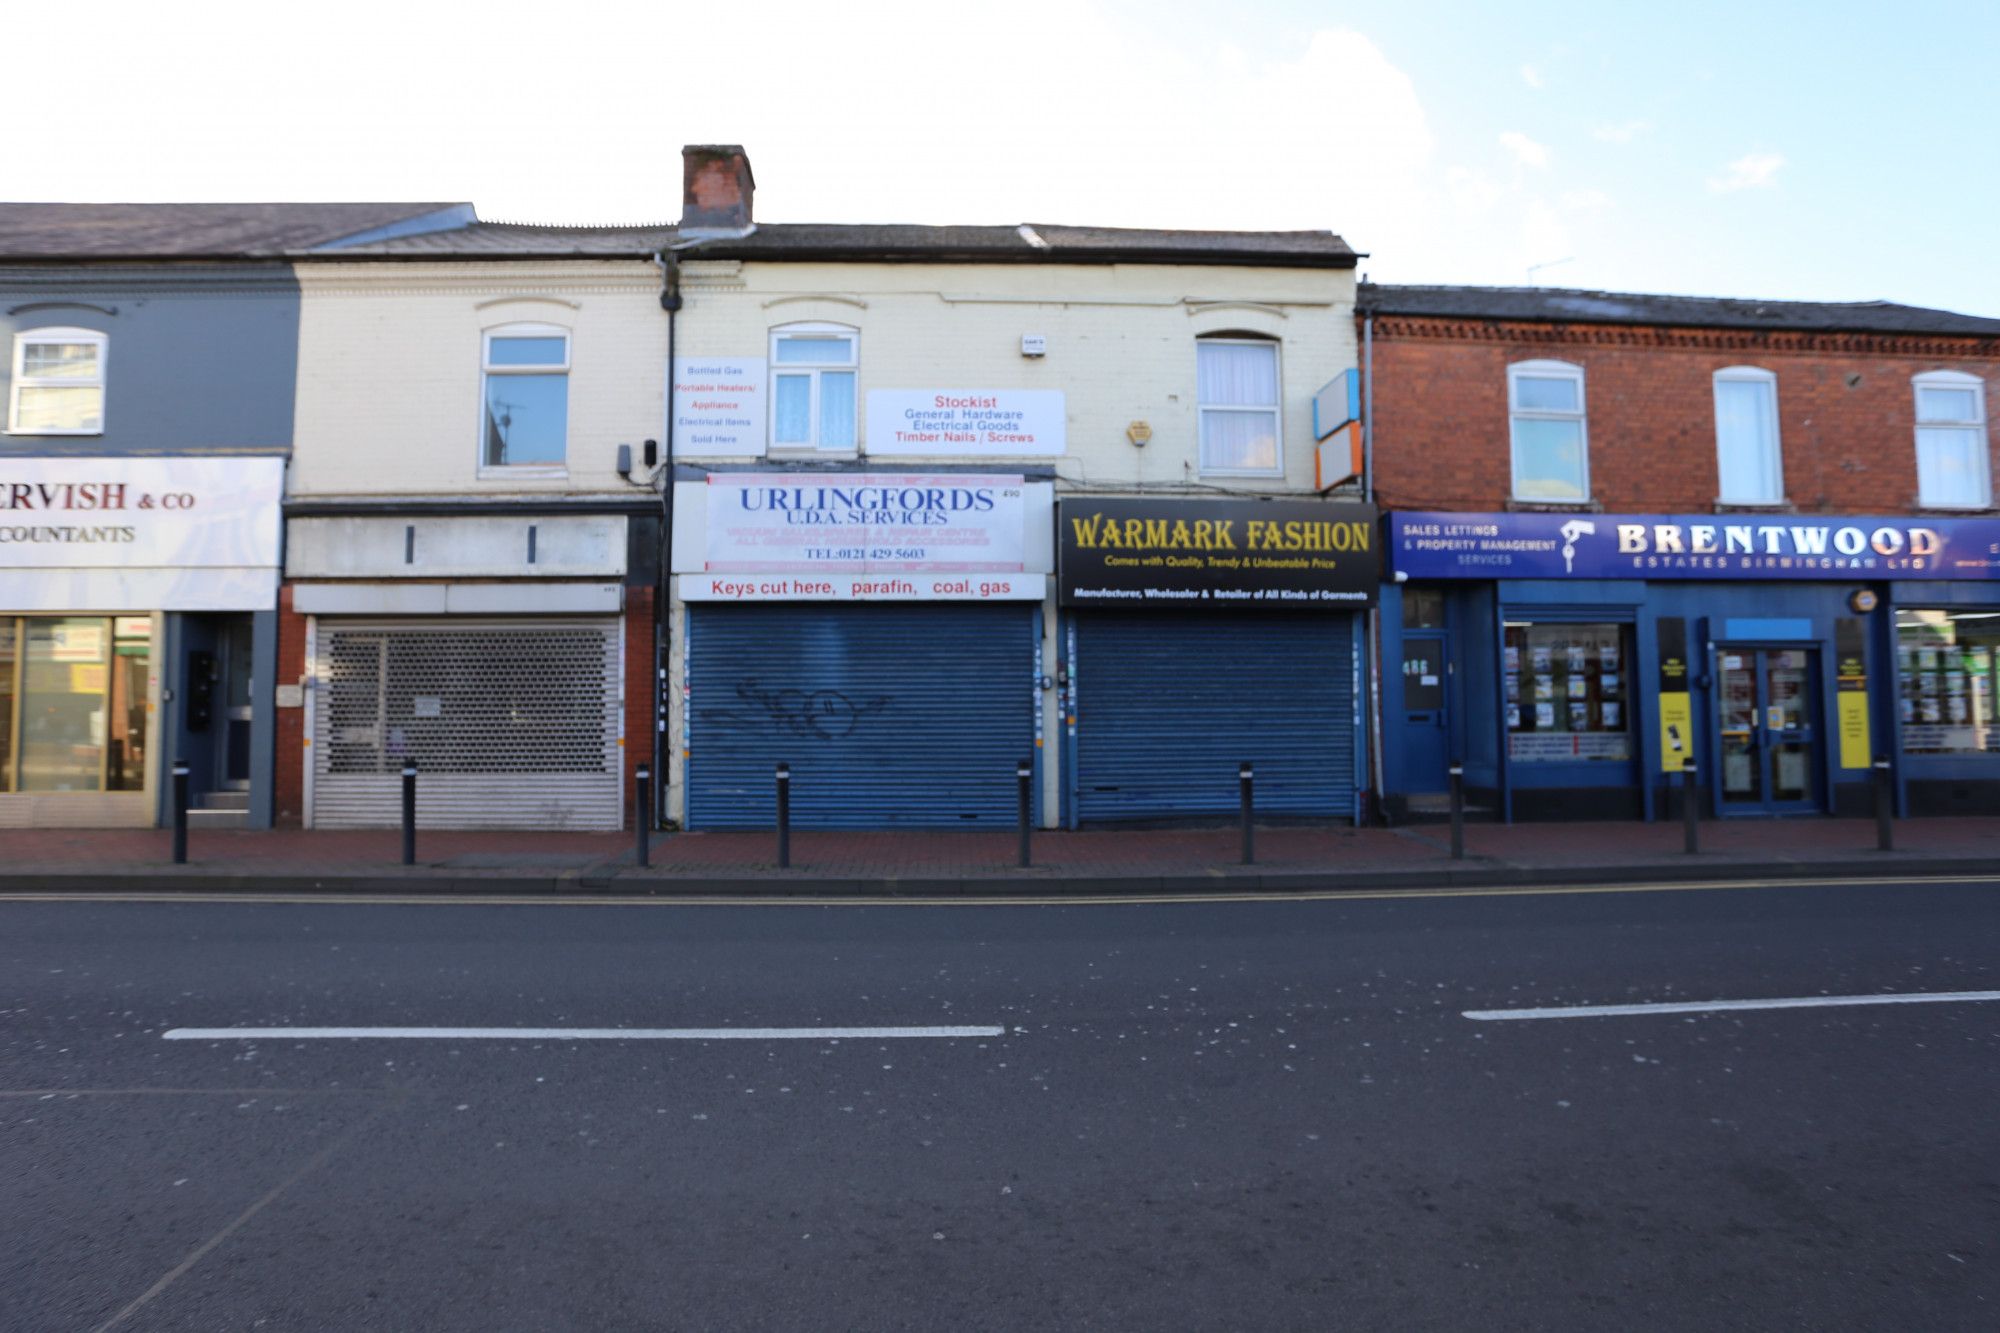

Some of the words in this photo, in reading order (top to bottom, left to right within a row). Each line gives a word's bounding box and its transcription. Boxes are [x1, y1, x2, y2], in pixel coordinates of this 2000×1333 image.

[935, 395, 997, 408] Stockist
[904, 408, 954, 420] General
[962, 409, 1023, 420] Hardware
[913, 420, 973, 431] Electrical
[977, 420, 1019, 431] Goods
[896, 432, 940, 443] Timber
[944, 432, 976, 443] Nails
[988, 432, 1034, 443] Screws
[0, 483, 127, 510] RVISH
[138, 494, 154, 510] &
[162, 493, 194, 510] CO
[740, 487, 994, 512] URLINGFORDS
[787, 510, 842, 525] U.D.A.
[847, 510, 948, 525] SERVICES
[1072, 512, 1237, 550] WARMARK
[1247, 520, 1369, 551] FASHION
[1403, 525, 1440, 536] SALES
[1444, 525, 1498, 537] LETTINGS
[1417, 539, 1476, 550] PROPERTY
[1480, 540, 1556, 551] MANAGEMENT
[1617, 524, 1940, 556] BRENTWOOD
[870, 549, 891, 559] 429
[895, 549, 925, 559] 5603
[1633, 556, 1728, 569] ESTATES
[711, 581, 755, 597] Keys
[761, 581, 787, 594] cut
[794, 580, 836, 595] here,
[851, 580, 917, 596] parafin,
[933, 579, 974, 595] coal,
[980, 582, 1010, 597] gas
